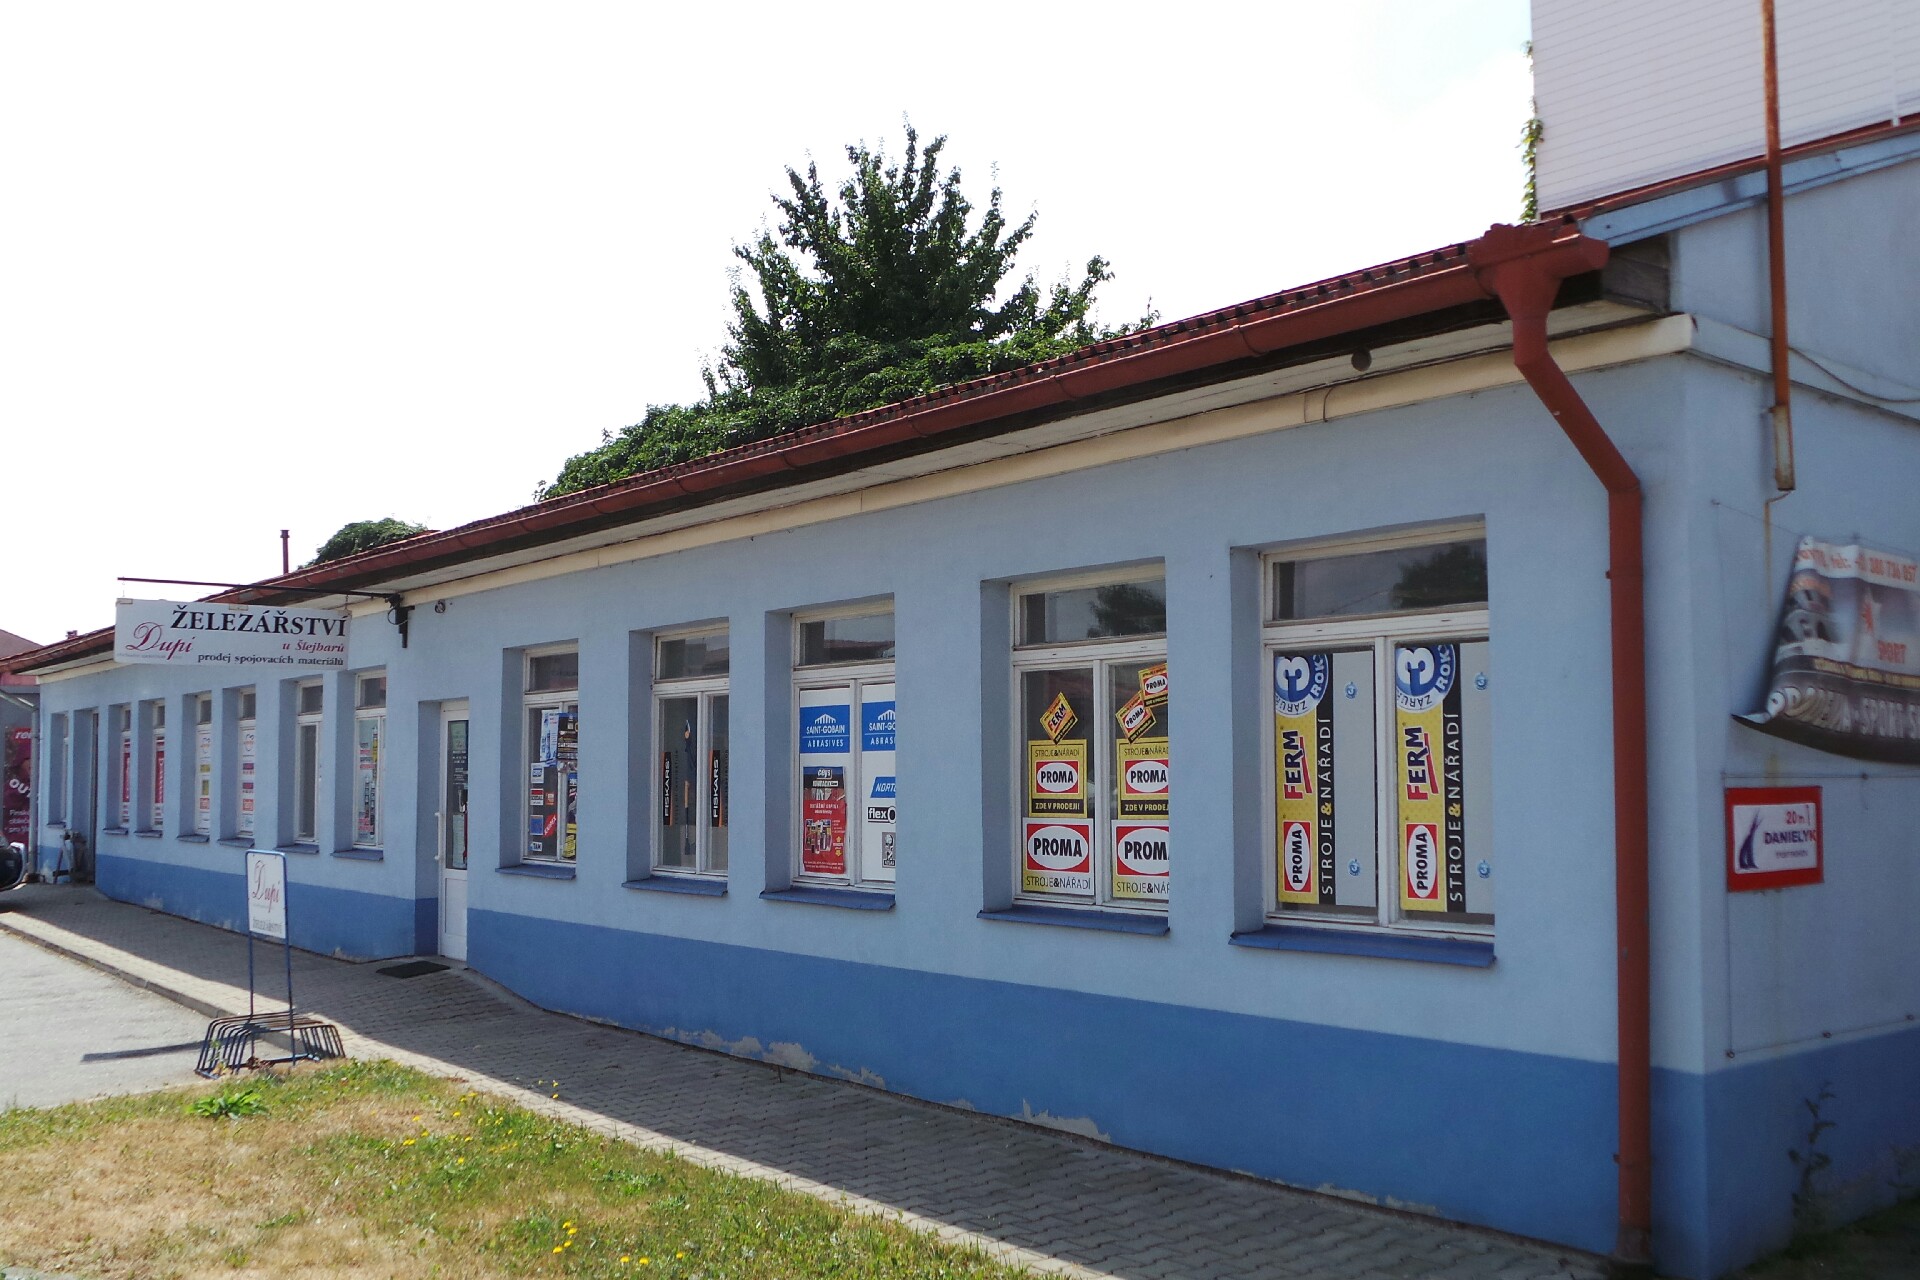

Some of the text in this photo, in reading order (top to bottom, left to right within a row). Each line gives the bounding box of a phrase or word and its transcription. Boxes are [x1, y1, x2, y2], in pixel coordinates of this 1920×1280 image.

[170, 604, 347, 637] ŽELEZÁŘSTVÍ
[126, 621, 195, 660] Dupi
[282, 642, 290, 650] u
[198, 653, 344, 666] prodej spojovacích materiálů
[1397, 647, 1434, 685] 3
[1146, 678, 1166, 690] PROMA
[1276, 656, 1310, 692] 3
[1047, 703, 1067, 732] FERM
[1125, 706, 1145, 727] PROMA
[806, 725, 845, 735] SAINT-GOBAIN
[807, 739, 844, 748] ABRASIVES
[1282, 729, 1304, 800] FERM
[1404, 727, 1429, 801] FERM
[1040, 768, 1074, 784] PROMA
[1130, 769, 1167, 784] PROMA
[1035, 802, 1047, 810] ZDE
[1047, 802, 1052, 810] V
[1033, 837, 1083, 858] PROMA
[1124, 841, 1169, 861] PROM
[1291, 829, 1303, 884] PROMA
[1417, 832, 1429, 890] PROMA
[1026, 874, 1091, 891] STROJE&NÁŘADÍ
